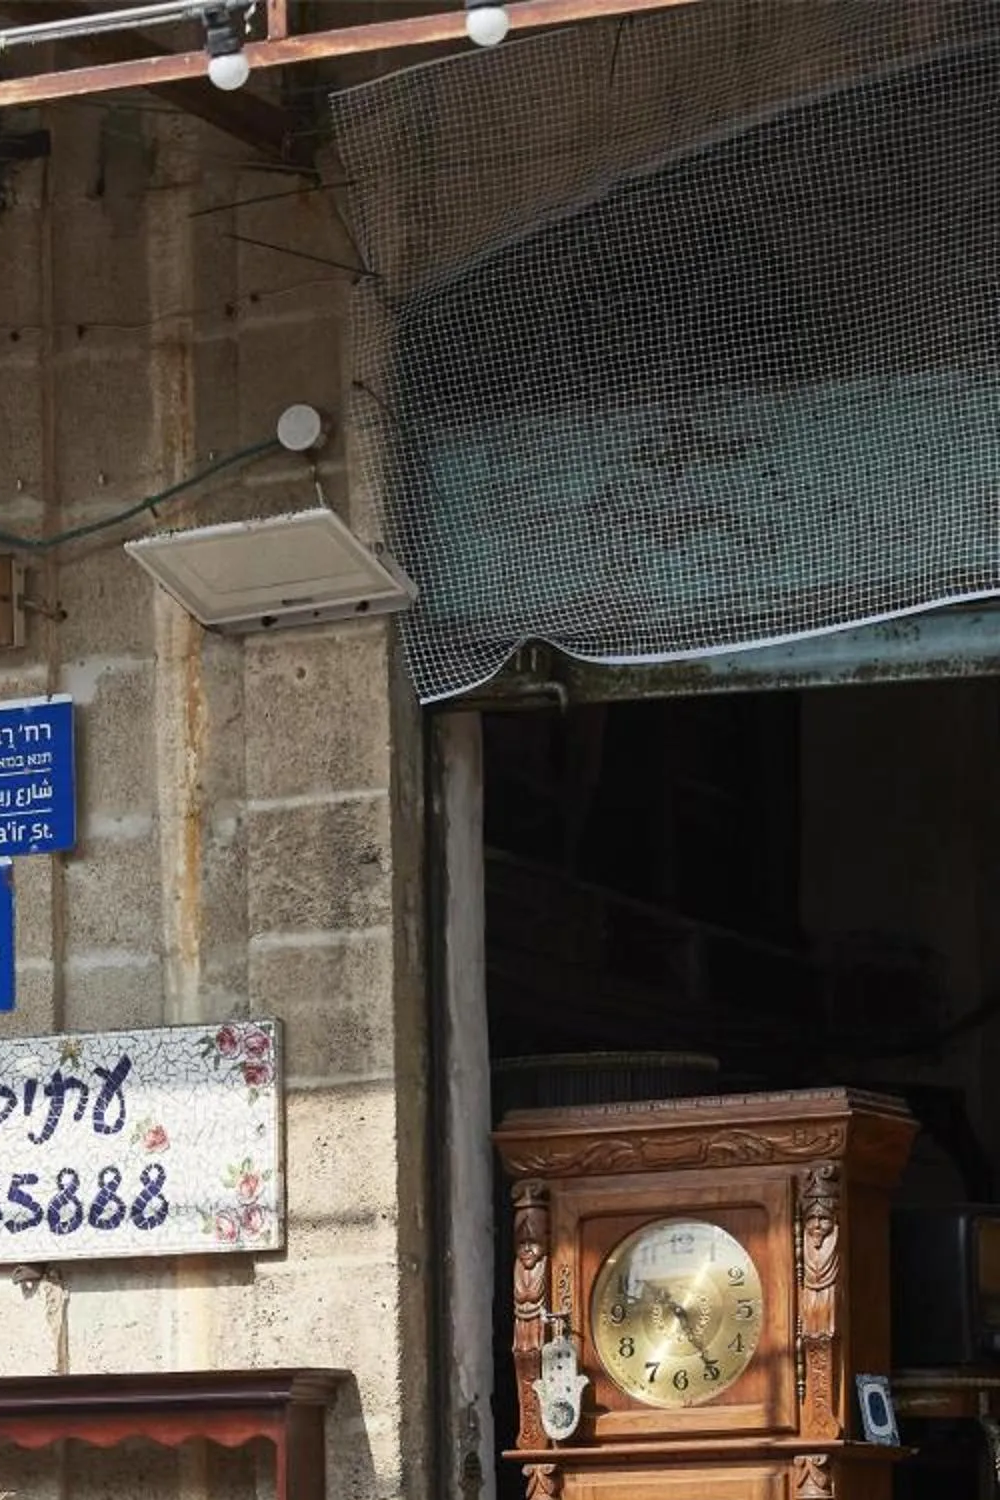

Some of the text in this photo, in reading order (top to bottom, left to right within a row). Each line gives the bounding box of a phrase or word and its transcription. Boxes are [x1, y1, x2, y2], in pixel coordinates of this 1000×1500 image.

[15, 778, 53, 806] شارع
[610, 1304, 627, 1324] 9
[618, 1336, 635, 1358] 8
[727, 1332, 745, 1353] 4
[644, 1361, 661, 1384] 7
[672, 1369, 689, 1391] 6
